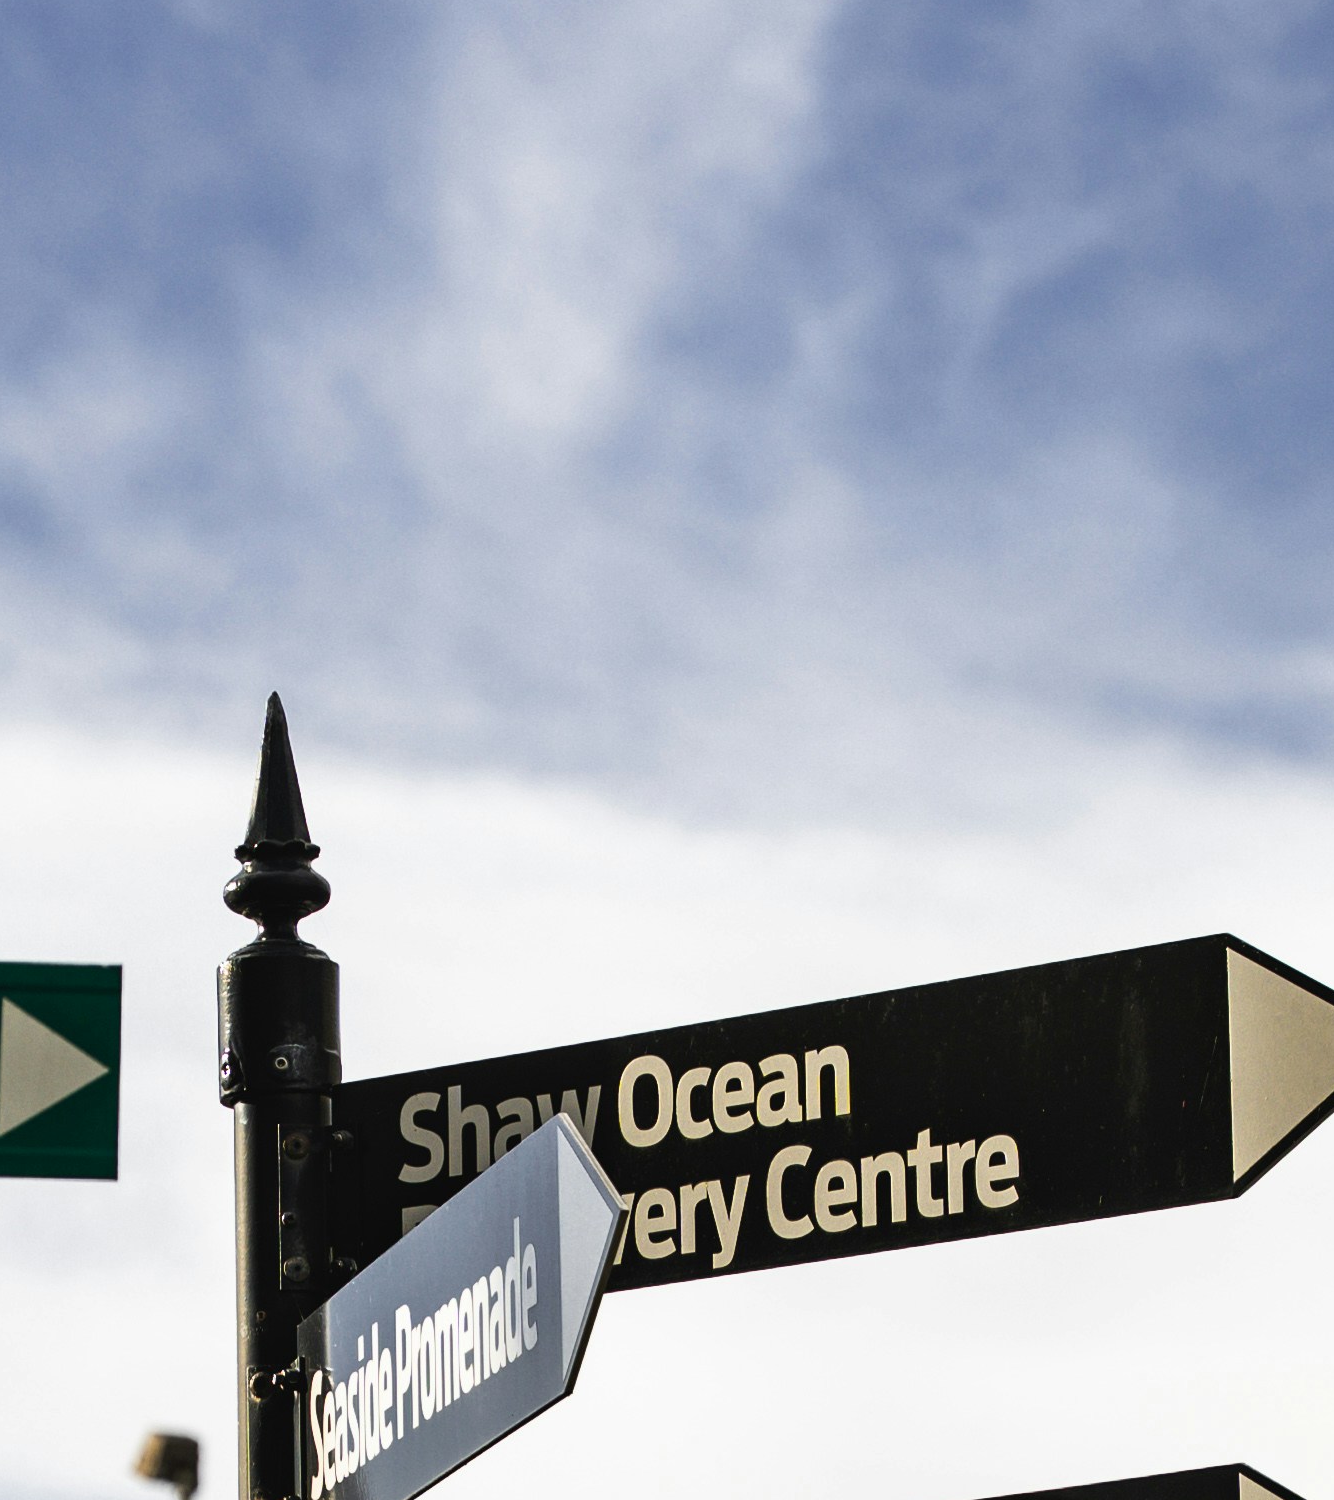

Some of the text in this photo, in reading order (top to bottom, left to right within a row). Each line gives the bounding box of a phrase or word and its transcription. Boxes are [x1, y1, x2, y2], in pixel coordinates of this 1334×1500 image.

[618, 1043, 851, 1149] Ocean
[765, 1129, 1020, 1241] Centre
[310, 1322, 393, 1500] Seaside
[394, 1216, 538, 1440] Promenade
